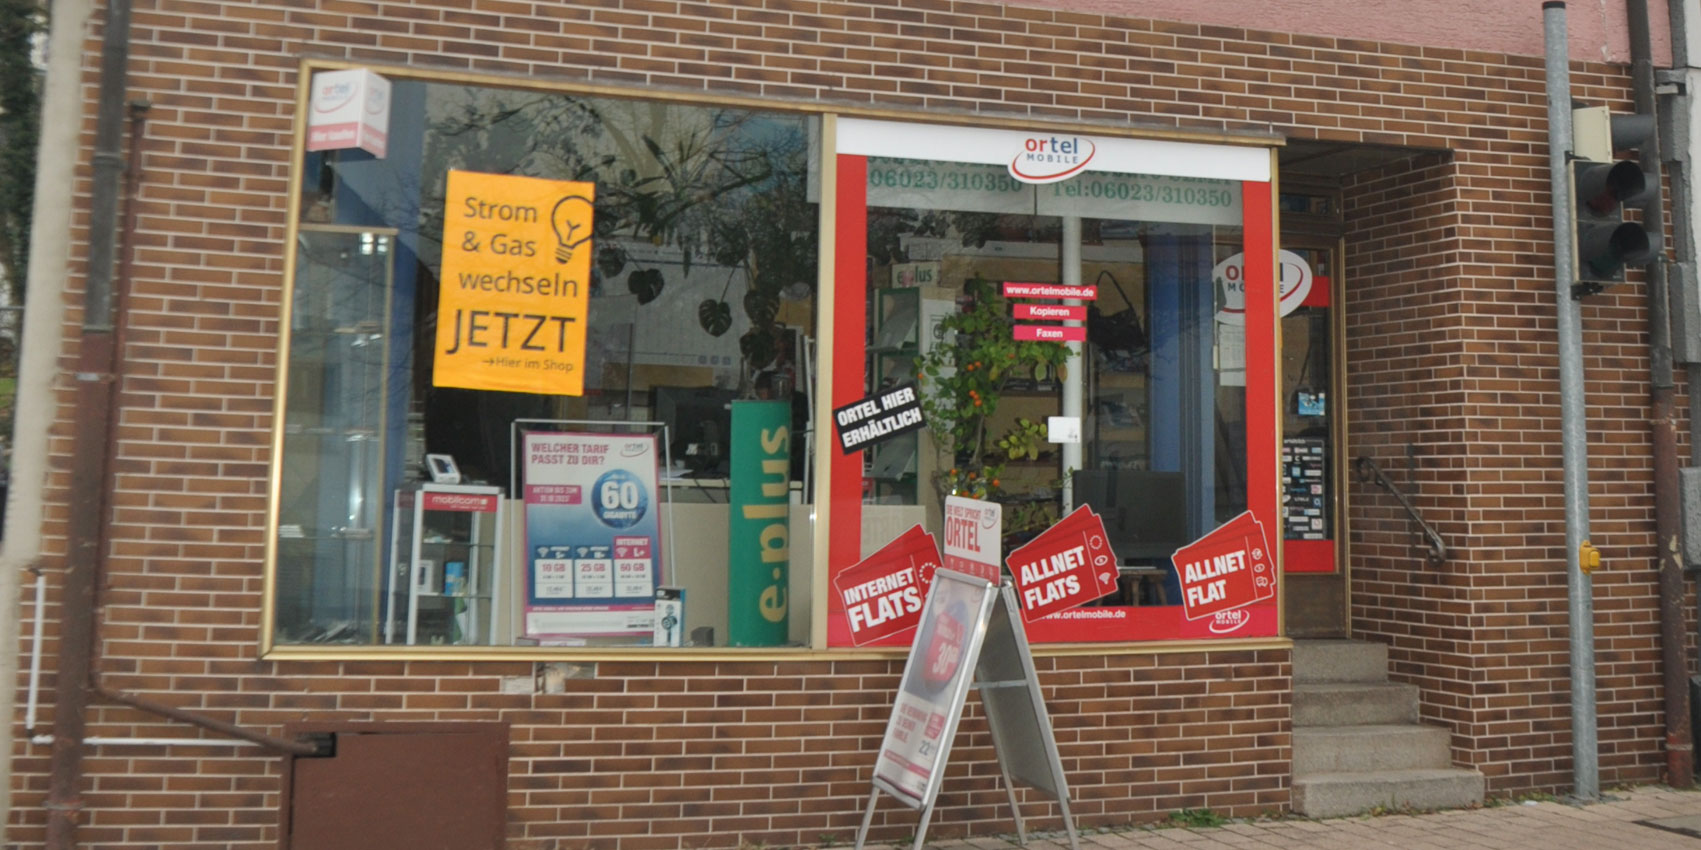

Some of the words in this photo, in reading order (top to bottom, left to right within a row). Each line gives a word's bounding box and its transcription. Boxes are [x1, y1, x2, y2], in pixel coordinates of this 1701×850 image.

[1025, 137, 1078, 154] ortel
[1027, 153, 1079, 164] MOBILE
[869, 168, 1023, 193] 06023/310350
[1052, 181, 1232, 207] Tel:06023/310350
[464, 197, 538, 223] Strom
[461, 231, 480, 252] &
[490, 233, 536, 257] Gas
[458, 270, 578, 297] wechseln
[1006, 286, 1095, 297] www.ortelmobile.de
[1029, 306, 1070, 317] Kopieren
[445, 309, 576, 355] JETZT
[1036, 328, 1064, 338] Faxen
[496, 357, 521, 368] Hier
[525, 359, 540, 369] im
[543, 360, 574, 372] Shop
[837, 399, 881, 427] ORTEL
[881, 386, 915, 411] HIER
[841, 406, 923, 449] ERHÄLTLICH
[531, 443, 579, 453] WELCHER
[582, 444, 609, 454] TARIF
[531, 454, 564, 464] PASST
[566, 455, 578, 465] ZU
[581, 455, 605, 465] DIR?
[432, 495, 480, 505] mobilcom
[600, 480, 639, 510] 60
[946, 516, 981, 553] ORTEL
[1021, 545, 1085, 586] ALLNET
[1184, 550, 1246, 584] ALLNET
[843, 567, 915, 605] INTERNET
[1024, 574, 1081, 610] FLATS
[1186, 579, 1227, 608] FLAT
[847, 586, 922, 633] FLATS
[1215, 609, 1241, 620] ortel
